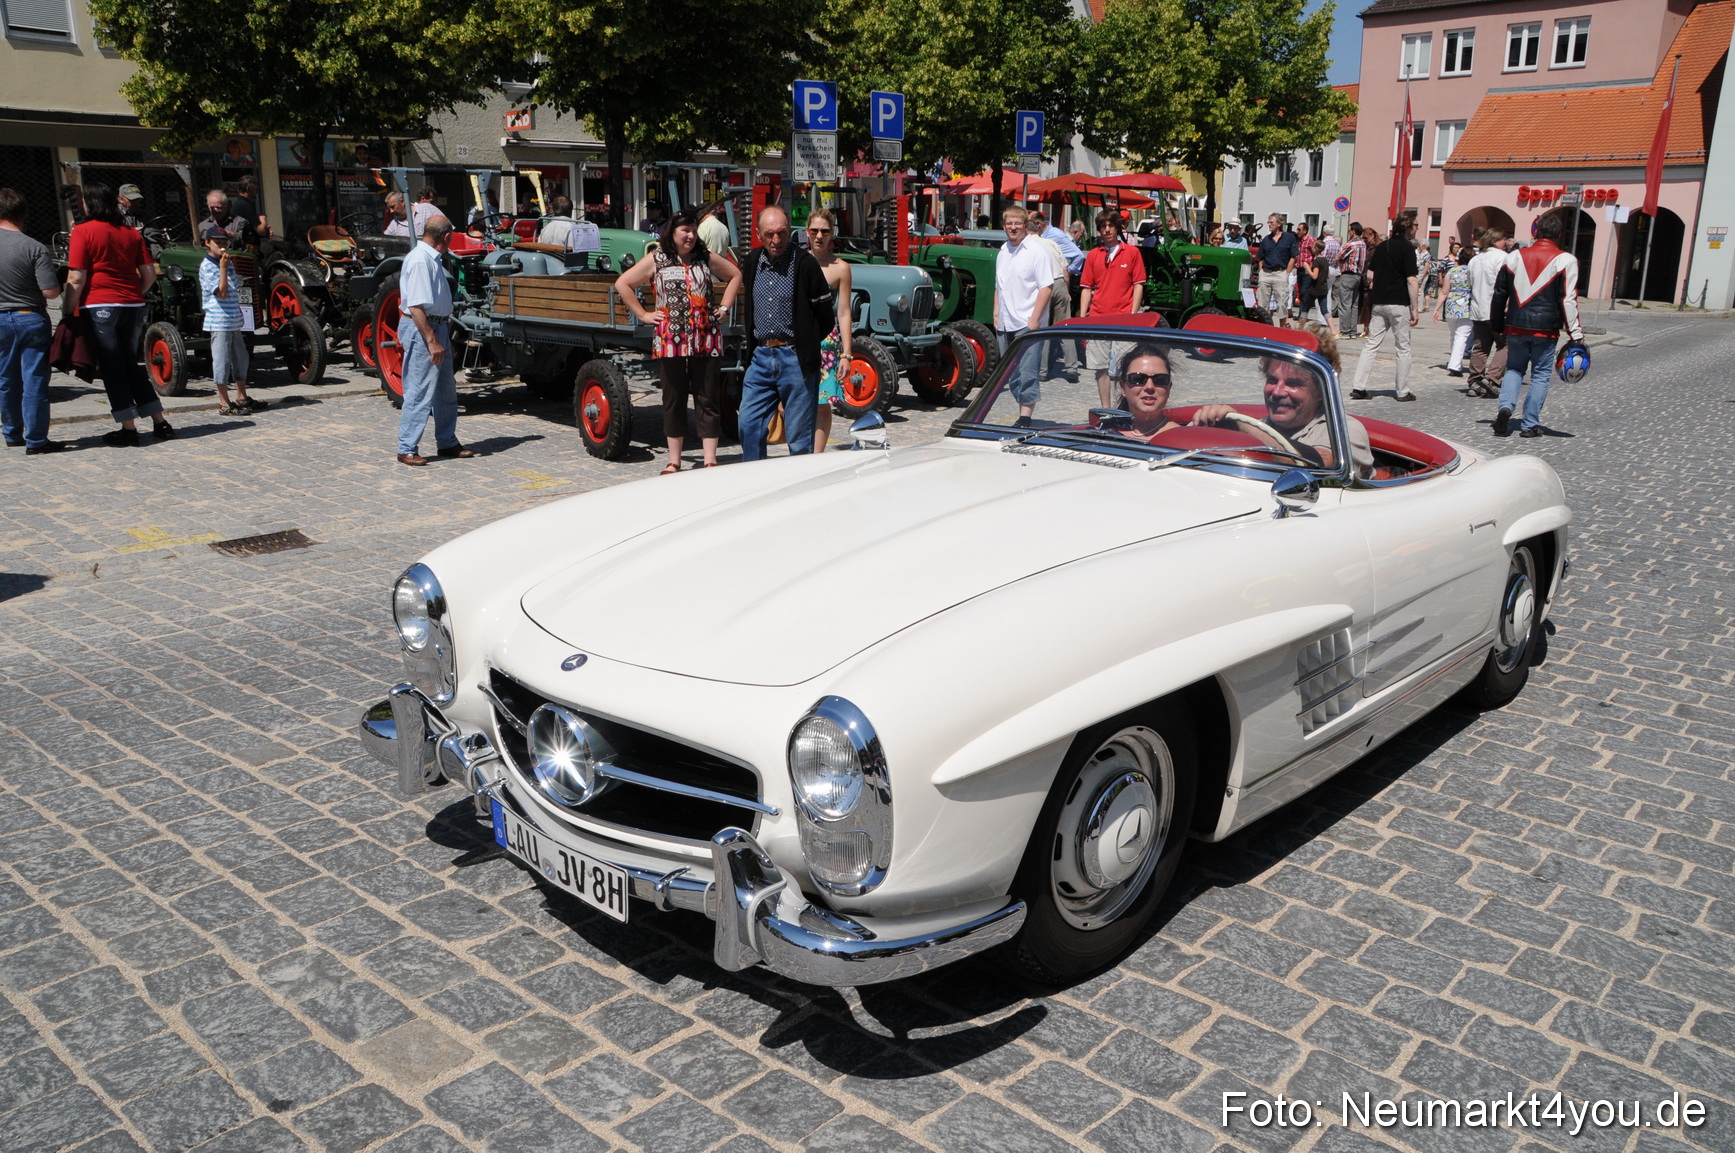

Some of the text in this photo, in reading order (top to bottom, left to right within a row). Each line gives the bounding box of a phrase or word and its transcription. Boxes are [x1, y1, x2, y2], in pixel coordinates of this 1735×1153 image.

[804, 87, 827, 123] P
[879, 98, 896, 132] P
[1022, 116, 1038, 148] P
[458, 147, 468, 155] 28
[797, 143, 834, 152] Parkschein
[800, 153, 831, 161] werktags
[583, 169, 603, 178] NKD
[754, 175, 770, 184] NKD
[1517, 185, 1619, 205] Sparsse
[240, 295, 250, 303] 55
[503, 812, 624, 915] LAU JV 8H
